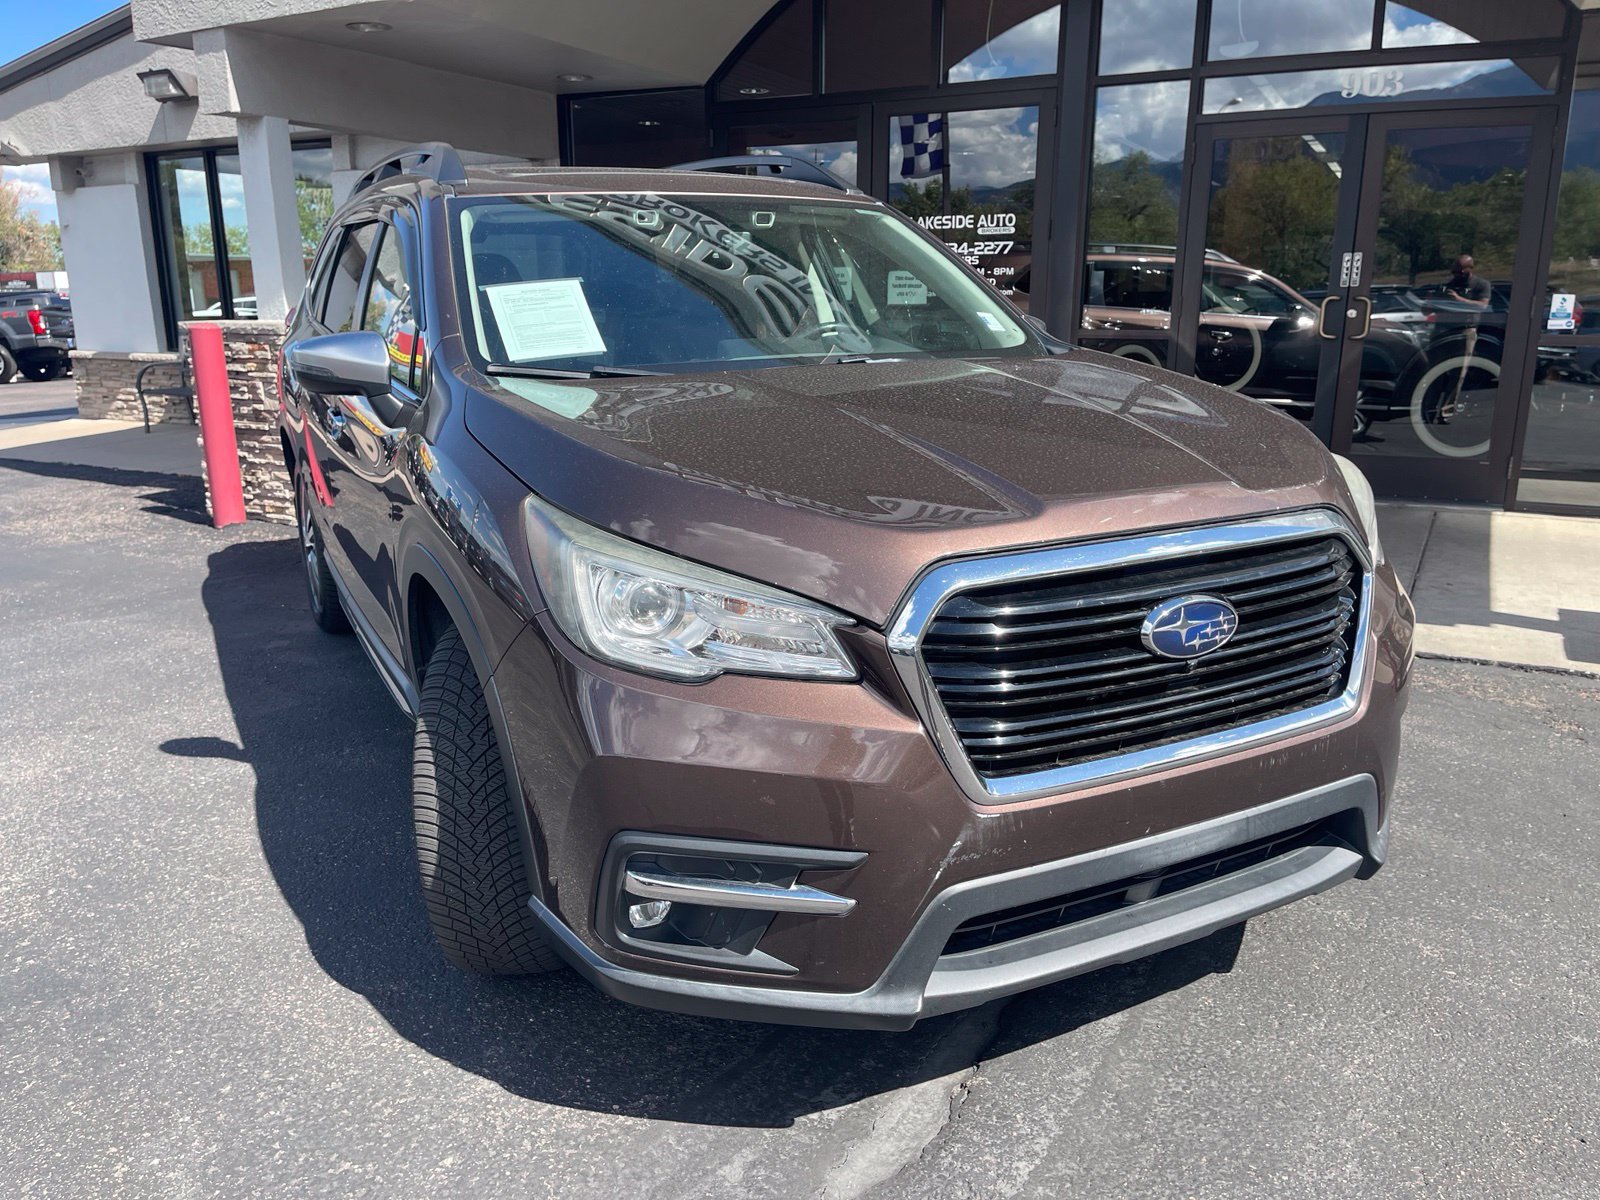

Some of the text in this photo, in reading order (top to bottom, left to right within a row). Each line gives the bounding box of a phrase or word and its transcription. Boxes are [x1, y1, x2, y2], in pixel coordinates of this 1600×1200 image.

[1341, 71, 1403, 98] 903
[911, 214, 1015, 230] AKESIDE AUTO
[944, 241, 1013, 254] 34-2277
